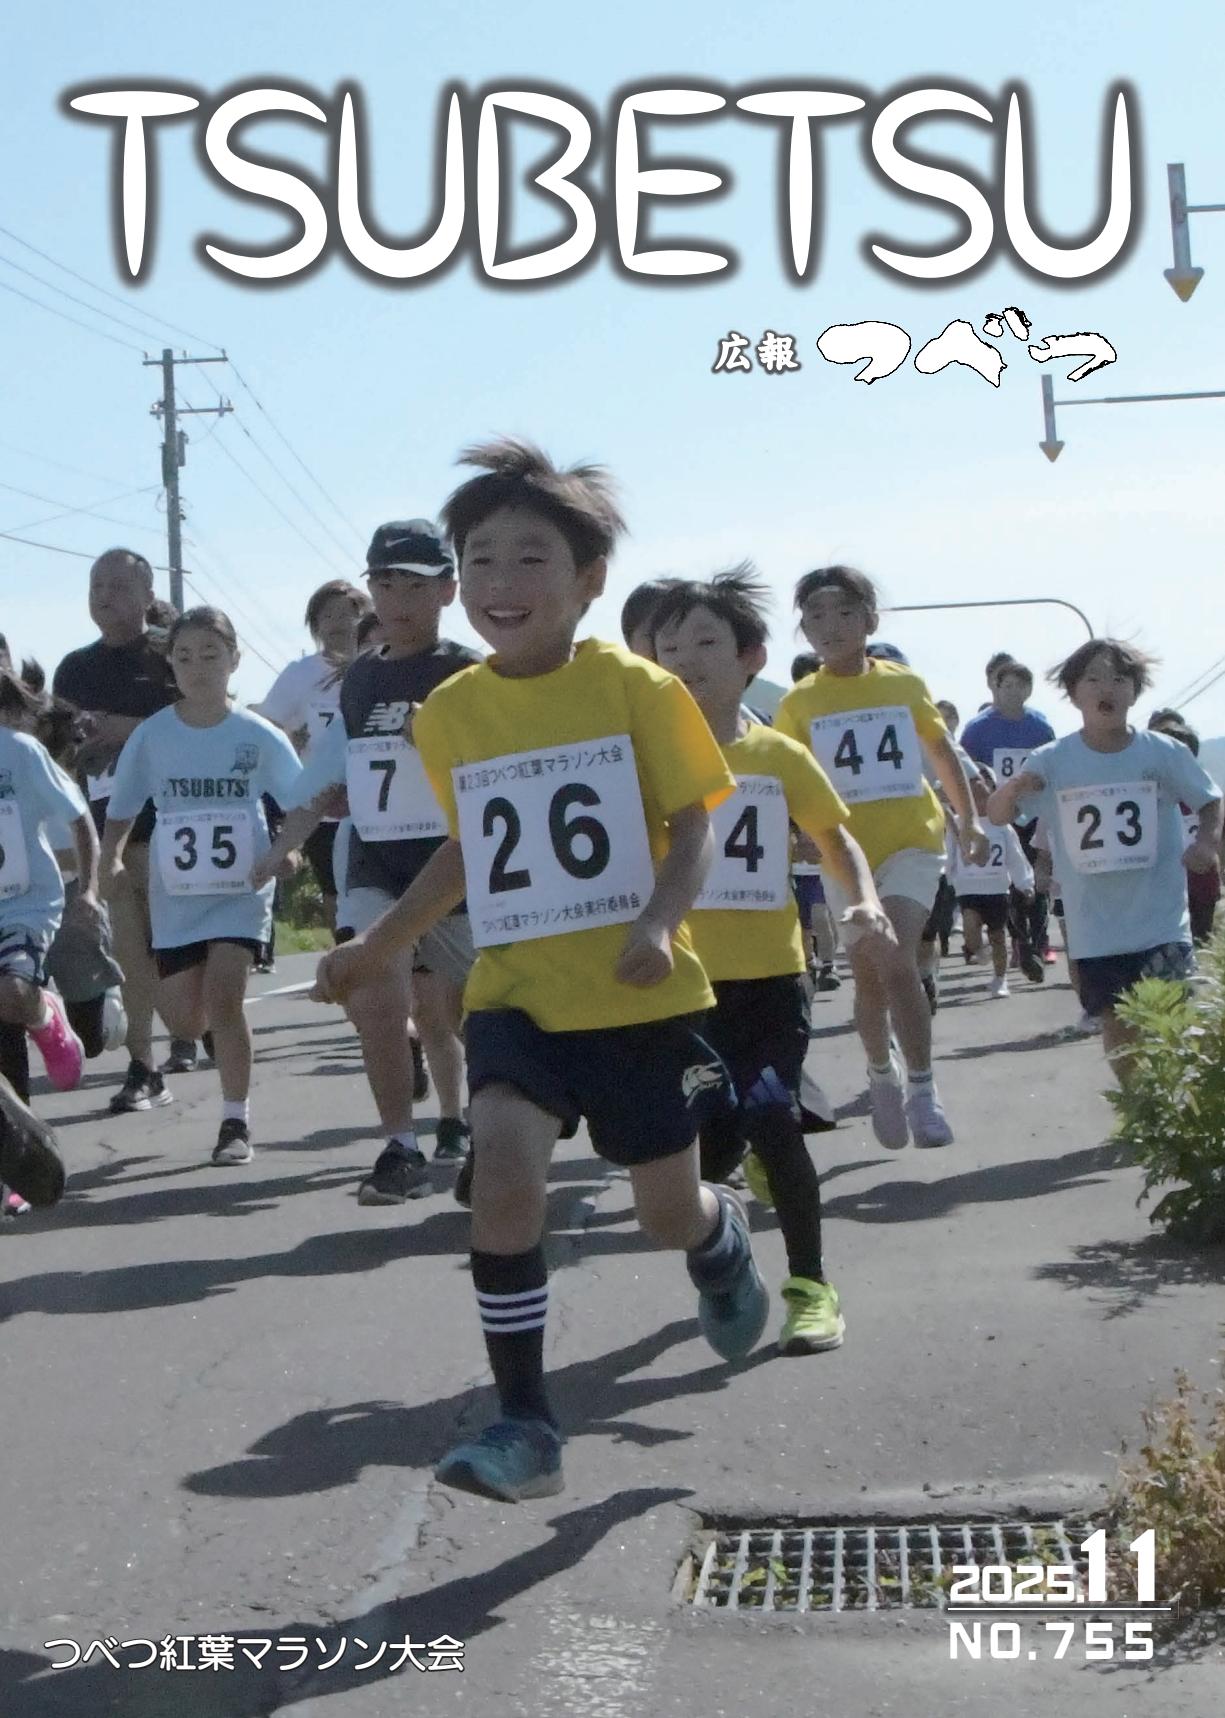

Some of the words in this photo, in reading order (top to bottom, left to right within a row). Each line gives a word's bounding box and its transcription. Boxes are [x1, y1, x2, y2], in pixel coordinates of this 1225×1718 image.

[833, 724, 904, 776] 44
[1001, 756, 1028, 777] 8
[368, 759, 397, 812] 7
[173, 825, 237, 871] 35
[482, 782, 611, 895] 26
[724, 805, 764, 873] 4
[1076, 800, 1143, 851] 23
